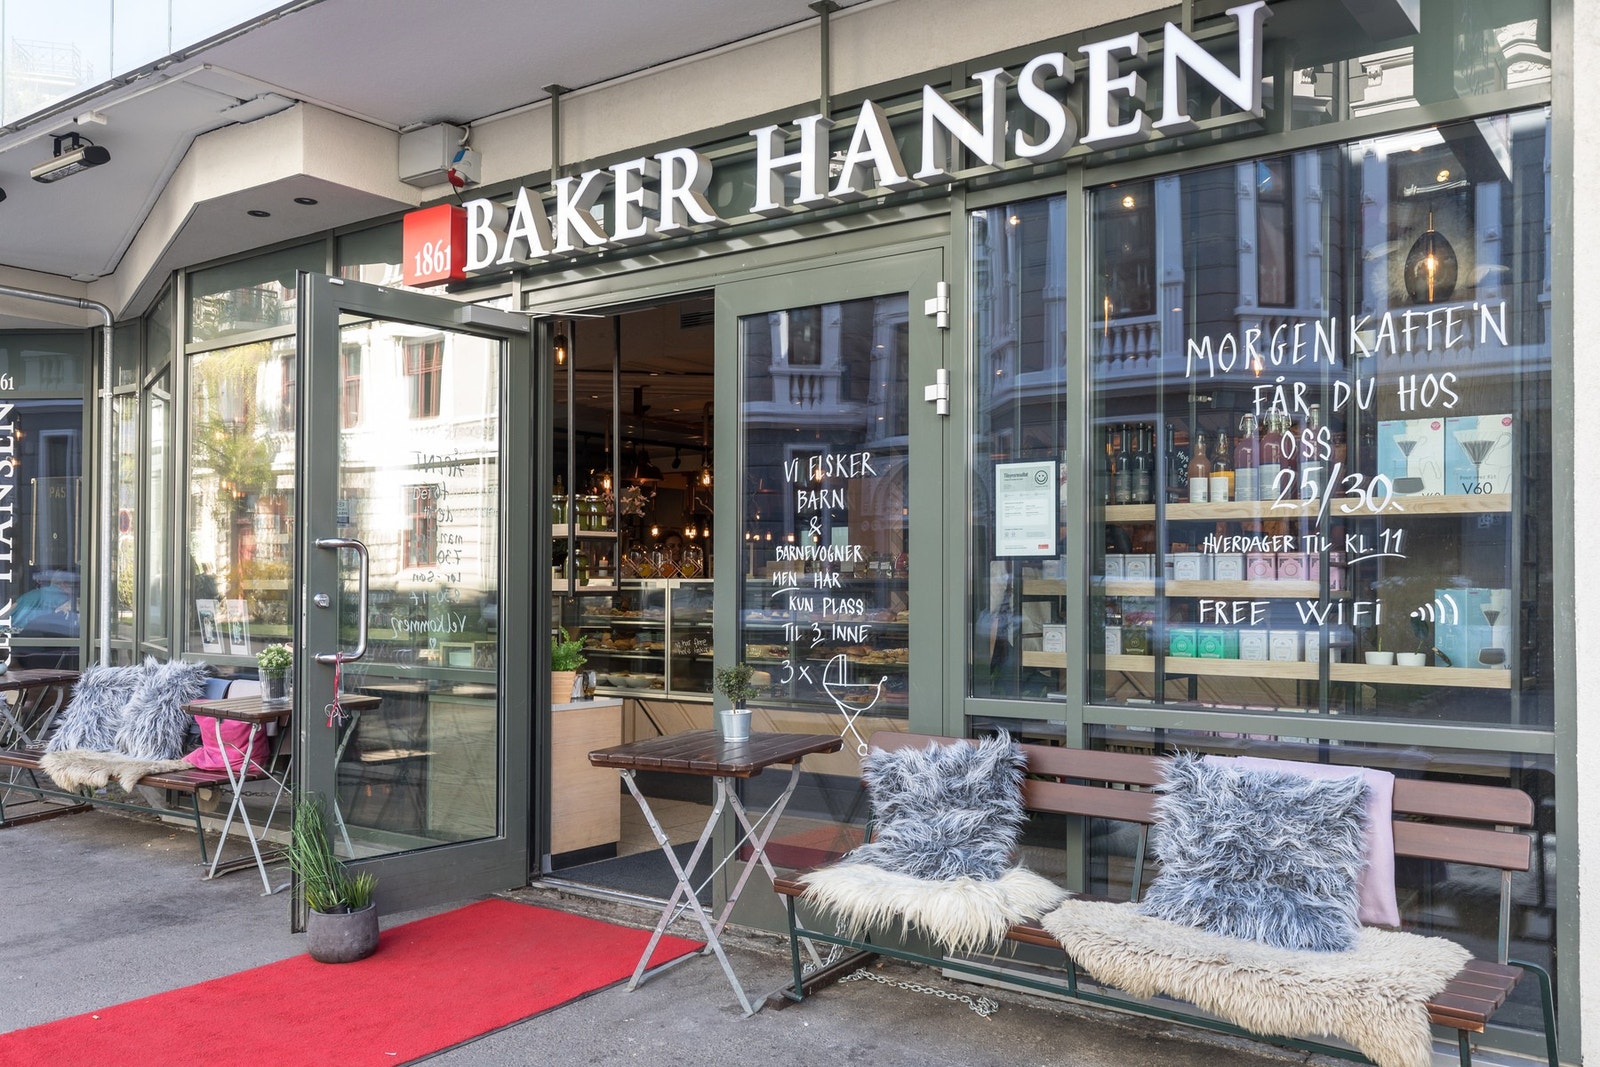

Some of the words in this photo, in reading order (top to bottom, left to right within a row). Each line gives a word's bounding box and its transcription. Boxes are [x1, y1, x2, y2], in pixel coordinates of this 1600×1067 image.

[462, 146, 716, 272] BAKER
[749, 1, 1266, 214] HANSEN
[413, 238, 450, 277] 1861
[1252, 375, 1310, 416] FÅR
[1333, 377, 1375, 413] DU
[1397, 372, 1459, 412] HOS
[1280, 425, 1331, 461] OSS
[809, 452, 877, 481] ELSKER
[797, 488, 845, 514] BARN
[1462, 482, 1493, 495] V60
[807, 516, 822, 537] &
[775, 544, 863, 563] BARNEVOGNER
[1202, 533, 1295, 555] HVERDAGER
[1379, 528, 1403, 554] 11
[772, 571, 798, 587] MEN
[814, 570, 841, 589] HAR
[789, 596, 814, 613] KUN
[822, 597, 864, 617] PLASS
[1199, 599, 1271, 626] FREE
[781, 622, 803, 642] TIL
[832, 623, 873, 643] INNE
